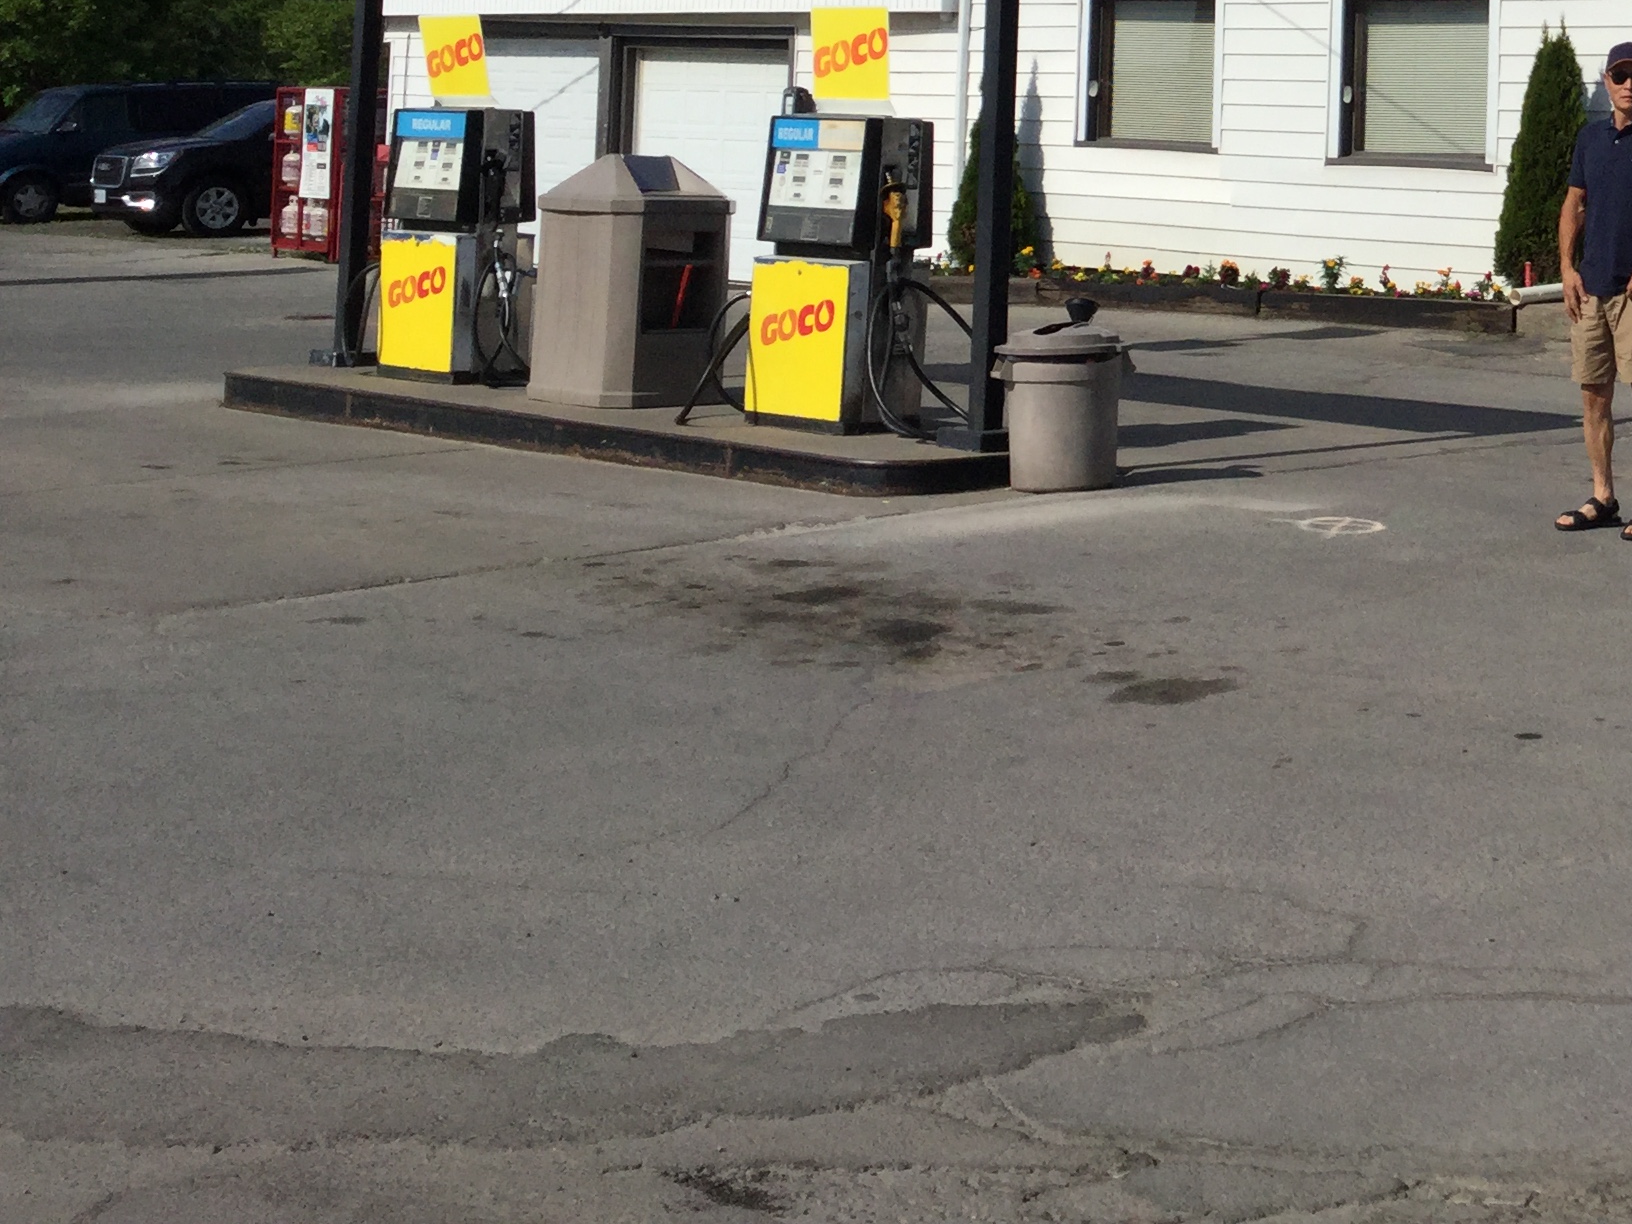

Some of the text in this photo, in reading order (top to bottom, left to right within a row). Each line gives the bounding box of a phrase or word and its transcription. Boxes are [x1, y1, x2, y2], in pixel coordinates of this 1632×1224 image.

[426, 33, 483, 79] GOCO
[813, 27, 888, 78] GOCO
[411, 118, 452, 131] REGULAR
[777, 127, 814, 141] REGULAR
[388, 266, 447, 308] GOCO
[760, 299, 835, 346] GOCO
